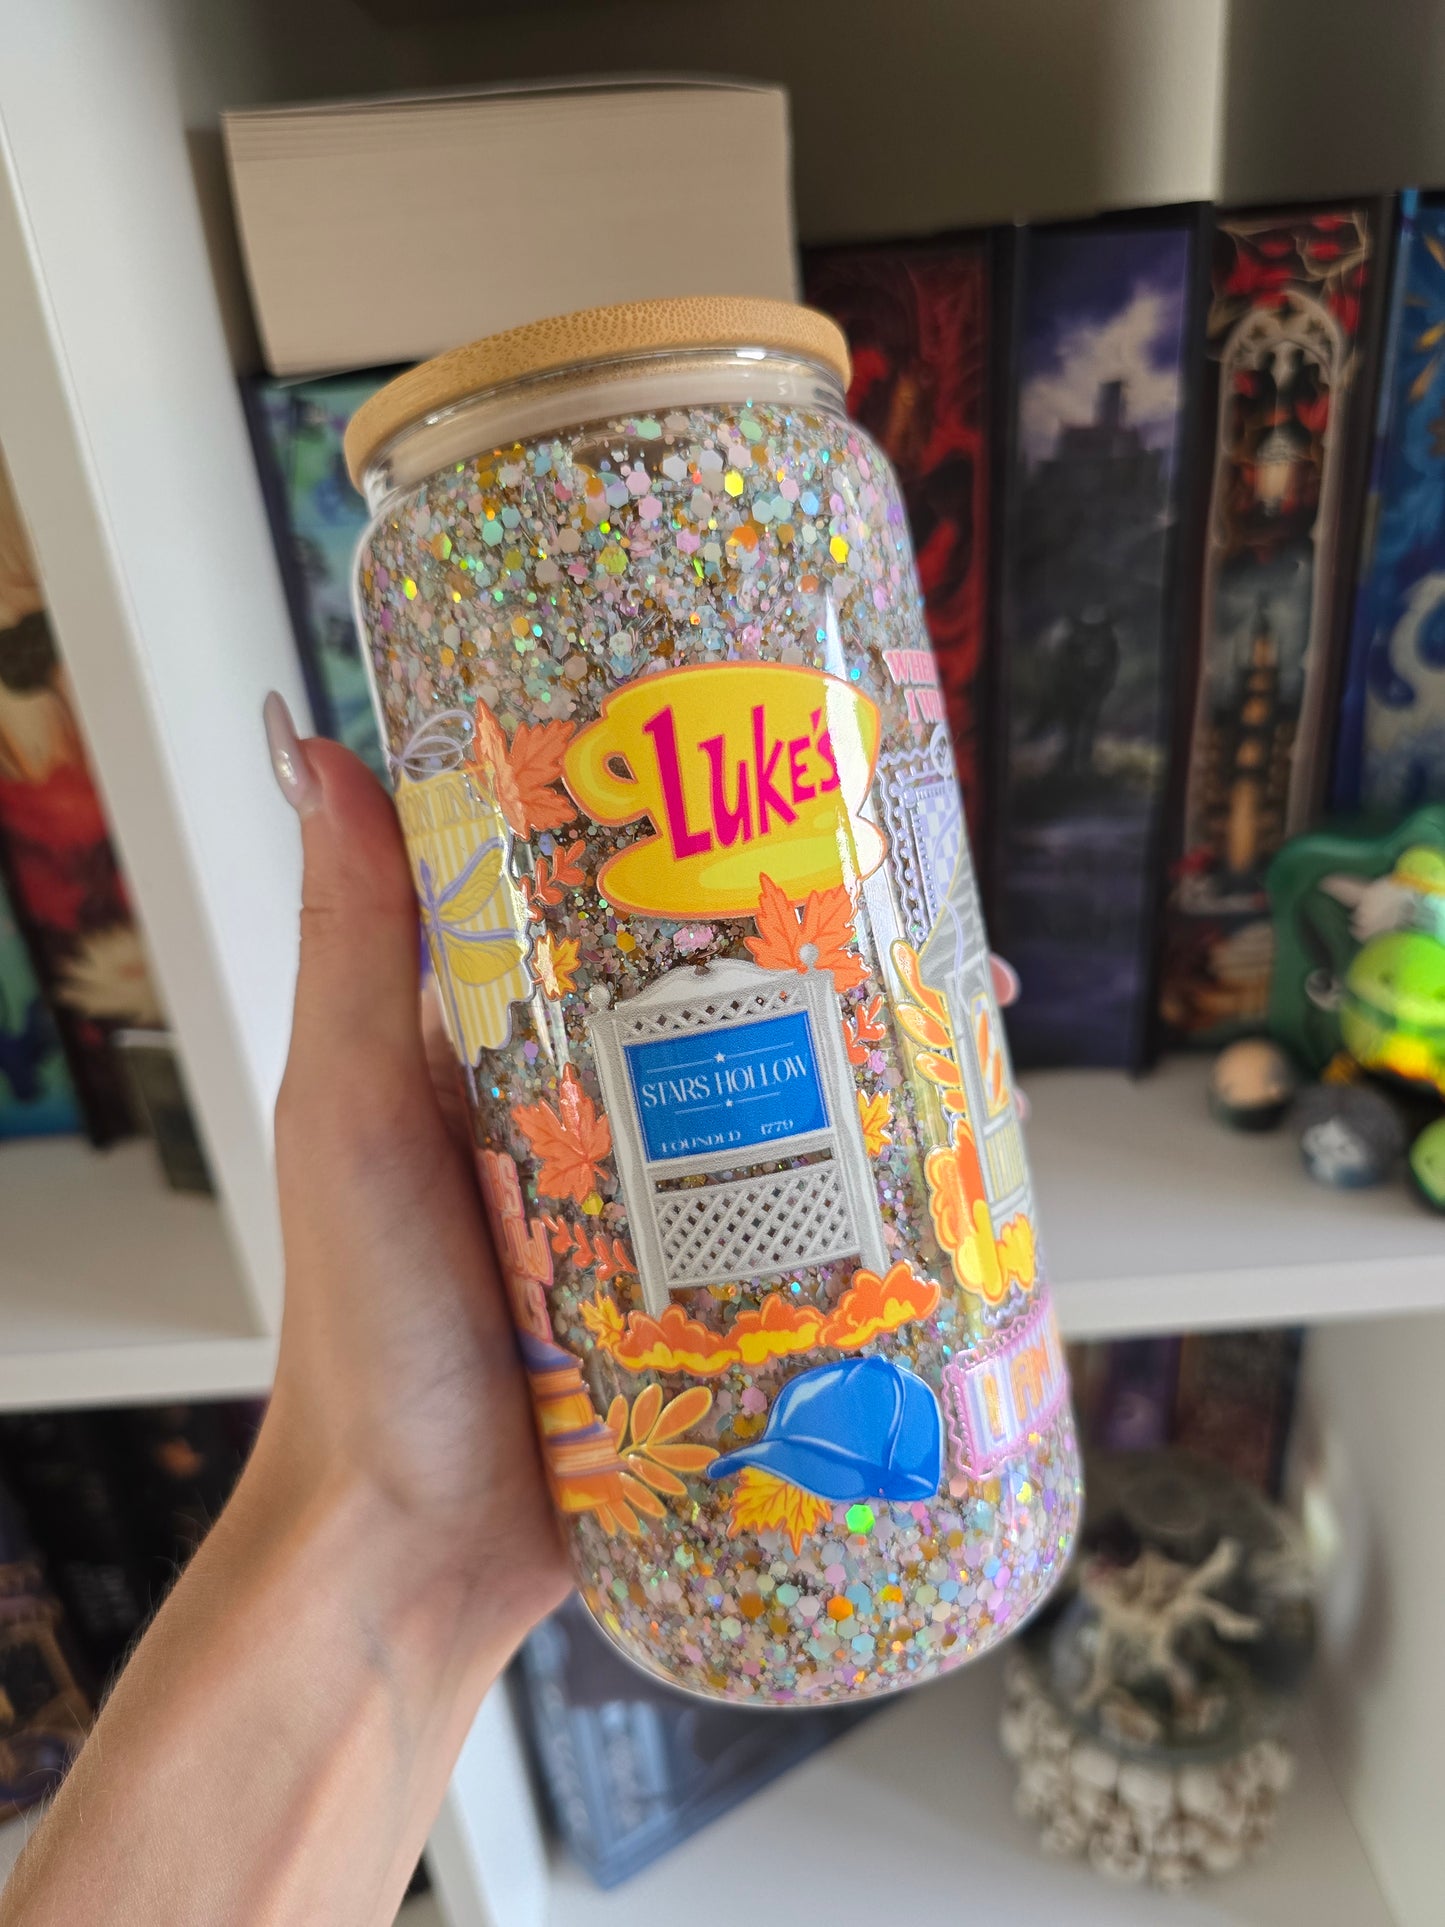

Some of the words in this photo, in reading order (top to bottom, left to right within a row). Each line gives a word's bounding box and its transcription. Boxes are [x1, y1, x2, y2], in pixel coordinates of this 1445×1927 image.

[641, 1074, 711, 1108] STARS
[715, 1055, 807, 1095] HOLLOW
[660, 1129, 742, 1153] FOUNDED
